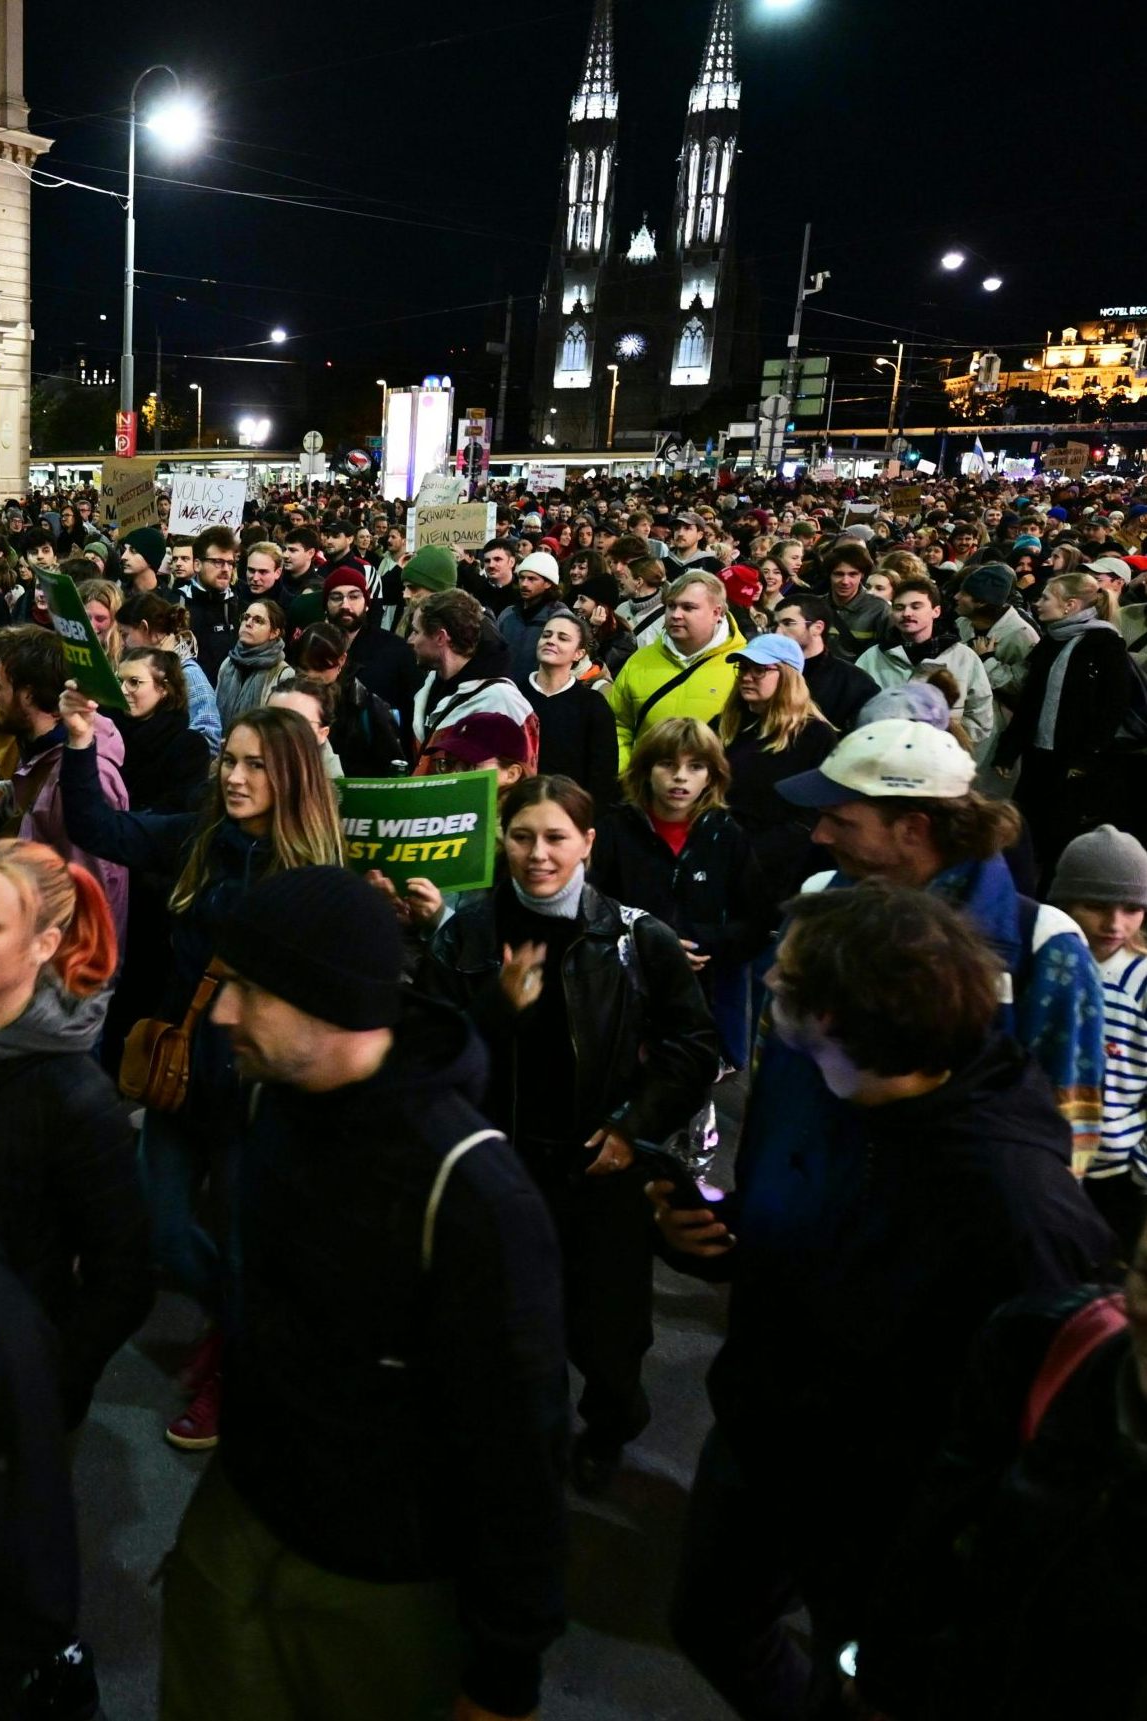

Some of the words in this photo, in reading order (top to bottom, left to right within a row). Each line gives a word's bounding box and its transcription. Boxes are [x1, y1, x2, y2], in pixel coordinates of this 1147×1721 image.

[1100, 307, 1128, 316] HOTEL
[420, 530, 449, 546] NEIN
[454, 529, 485, 542] DANKE
[62, 642, 92, 667] ETZT
[377, 812, 478, 838] WIEDER
[347, 842, 382, 860] ST
[386, 838, 467, 862] JETZT
